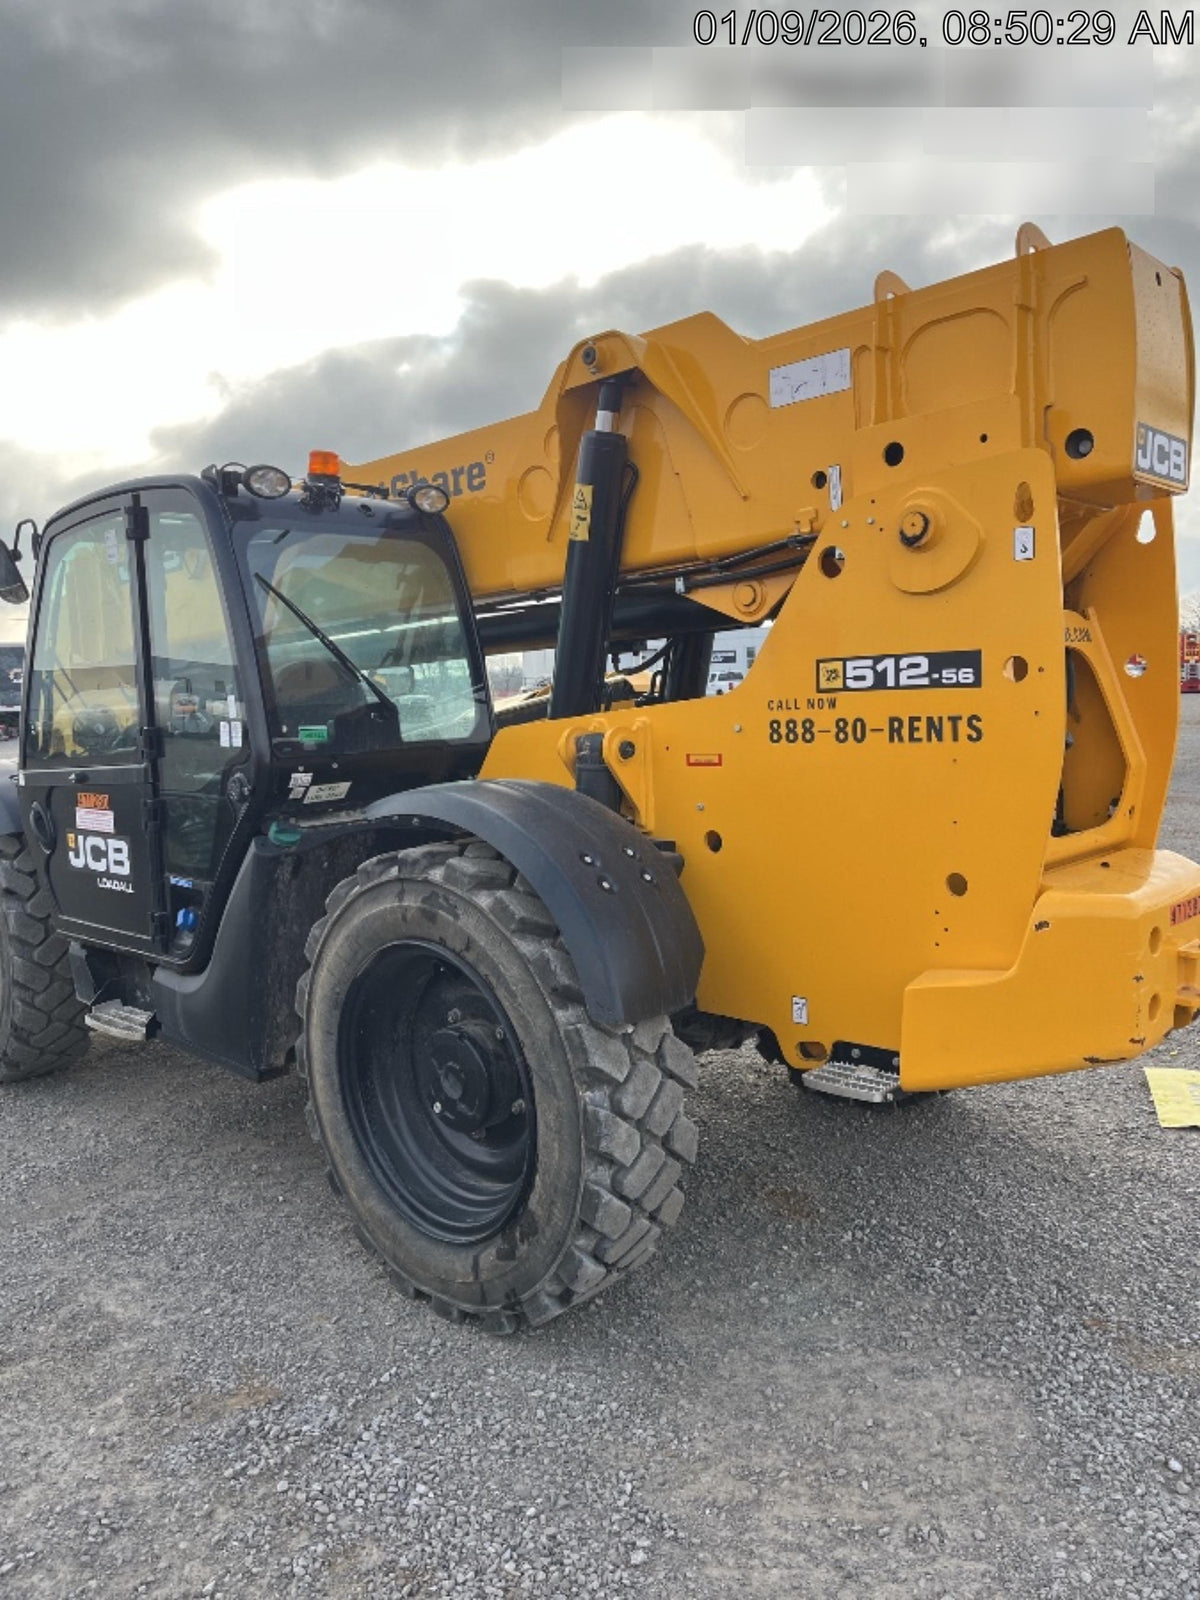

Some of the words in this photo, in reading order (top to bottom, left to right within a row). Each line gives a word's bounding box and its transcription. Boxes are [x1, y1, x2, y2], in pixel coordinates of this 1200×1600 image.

[1137, 429, 1185, 481] JCB
[845, 655, 976, 689] 512-56
[768, 698, 801, 711] CALL
[806, 697, 838, 710] NOW
[768, 714, 984, 744] 888-80-RENTS
[68, 834, 131, 876] JCB
[97, 878, 135, 893] LOADALL
